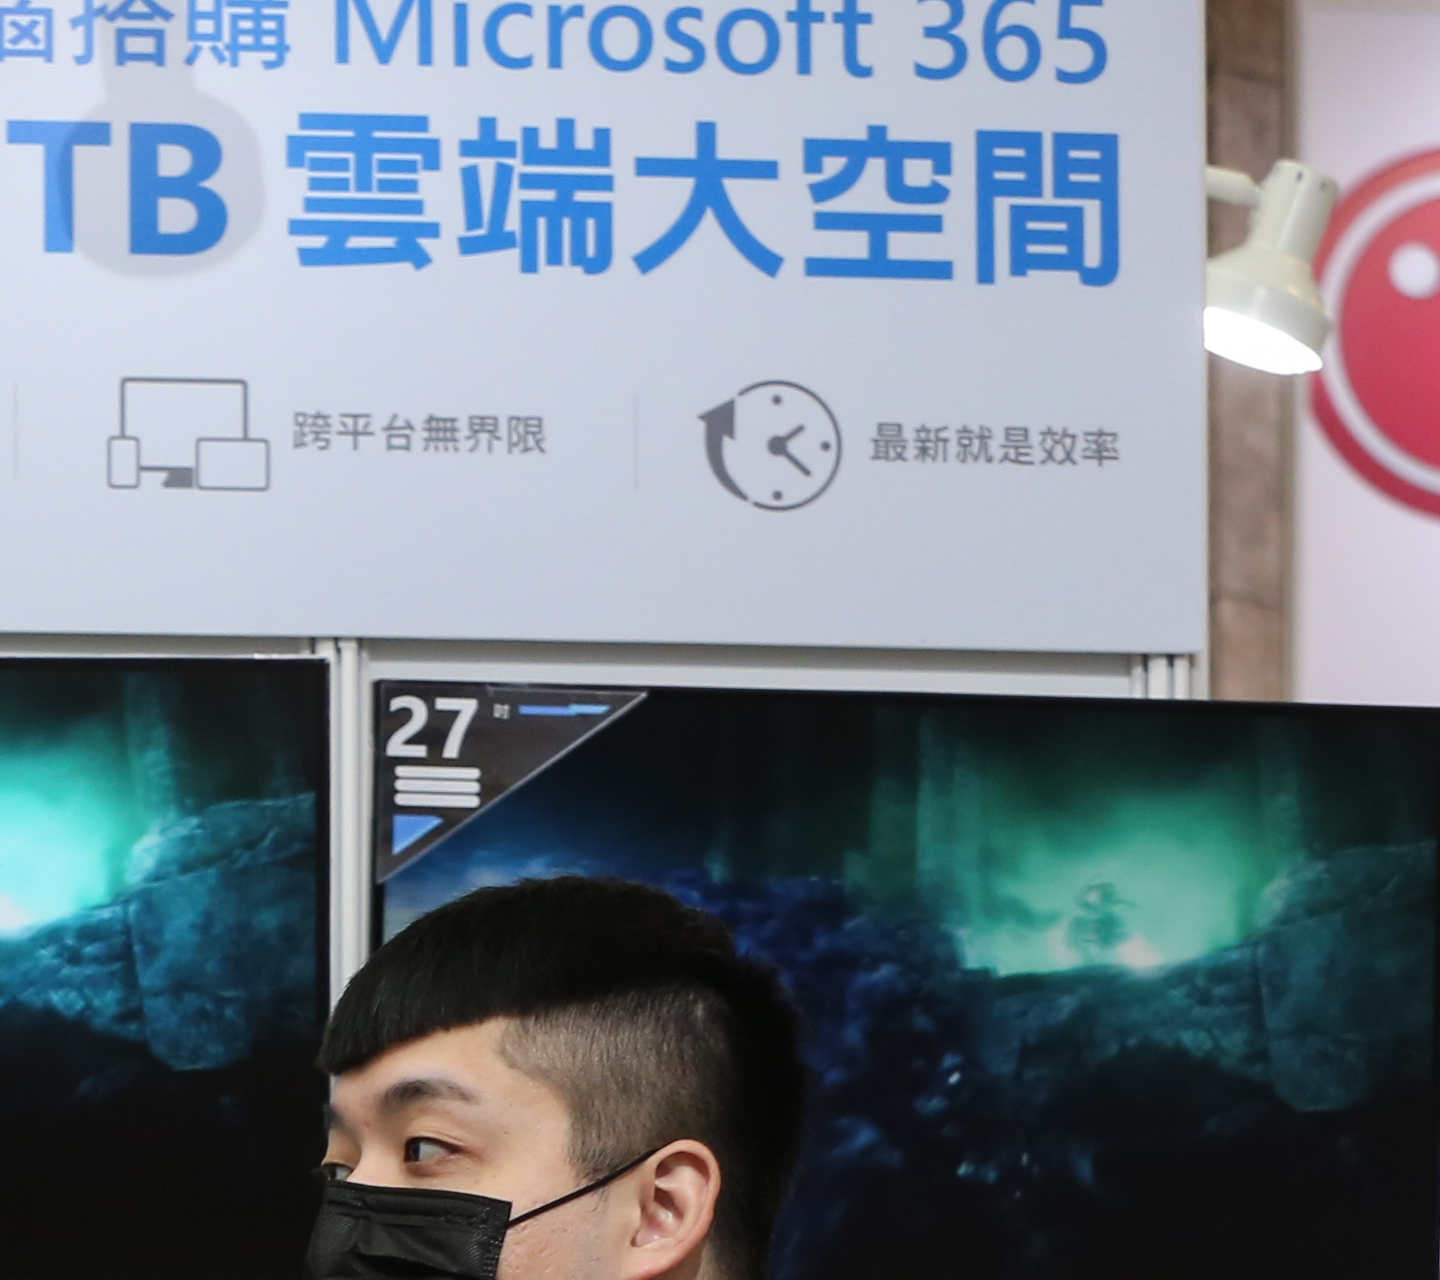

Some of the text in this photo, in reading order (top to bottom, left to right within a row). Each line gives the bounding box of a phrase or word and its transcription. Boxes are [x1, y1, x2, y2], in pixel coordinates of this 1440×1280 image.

[332, 0, 875, 80] Microsoft
[910, 0, 1111, 85] 365
[286, 108, 1122, 288] 雲端大空間
[290, 411, 548, 456] 跨平台無界限
[868, 421, 1120, 469] 最新就是效率
[385, 694, 479, 760] 27
